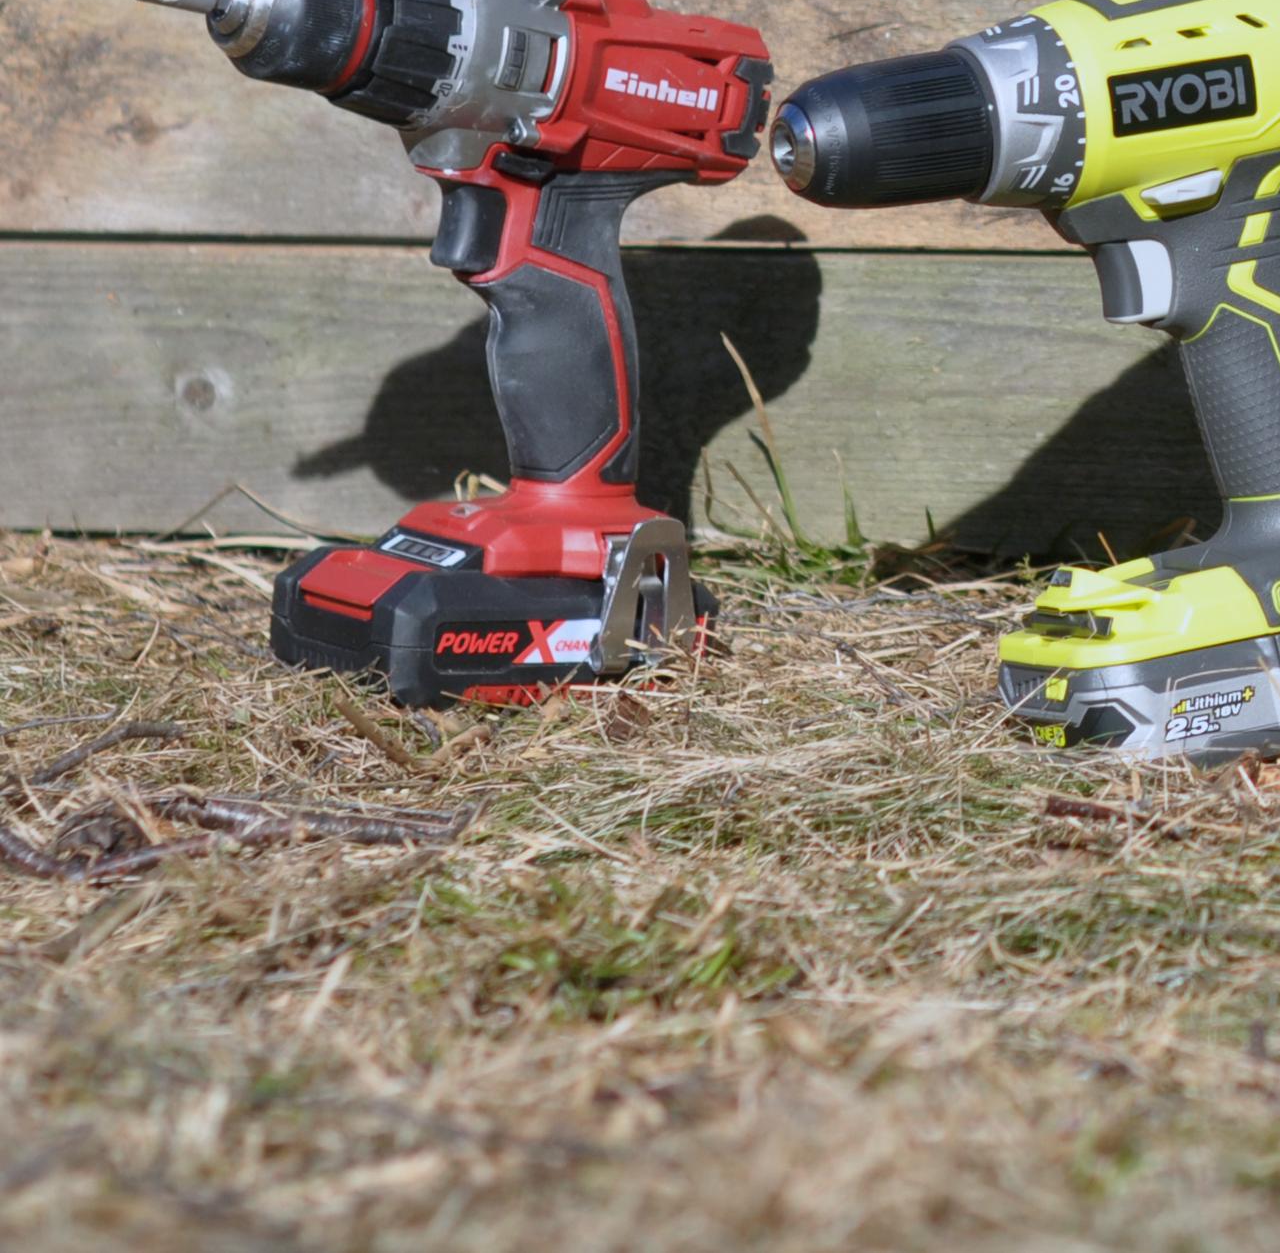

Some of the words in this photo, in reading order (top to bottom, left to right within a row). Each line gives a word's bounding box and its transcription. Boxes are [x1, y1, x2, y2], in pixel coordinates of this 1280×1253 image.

[437, 82, 453, 97] 20
[604, 67, 718, 111] Einhell
[1055, 74, 1080, 108] 20
[1115, 66, 1247, 124] RYOBI
[1051, 172, 1075, 193] 16
[436, 631, 520, 655] POWER
[555, 638, 591, 652] CHAN
